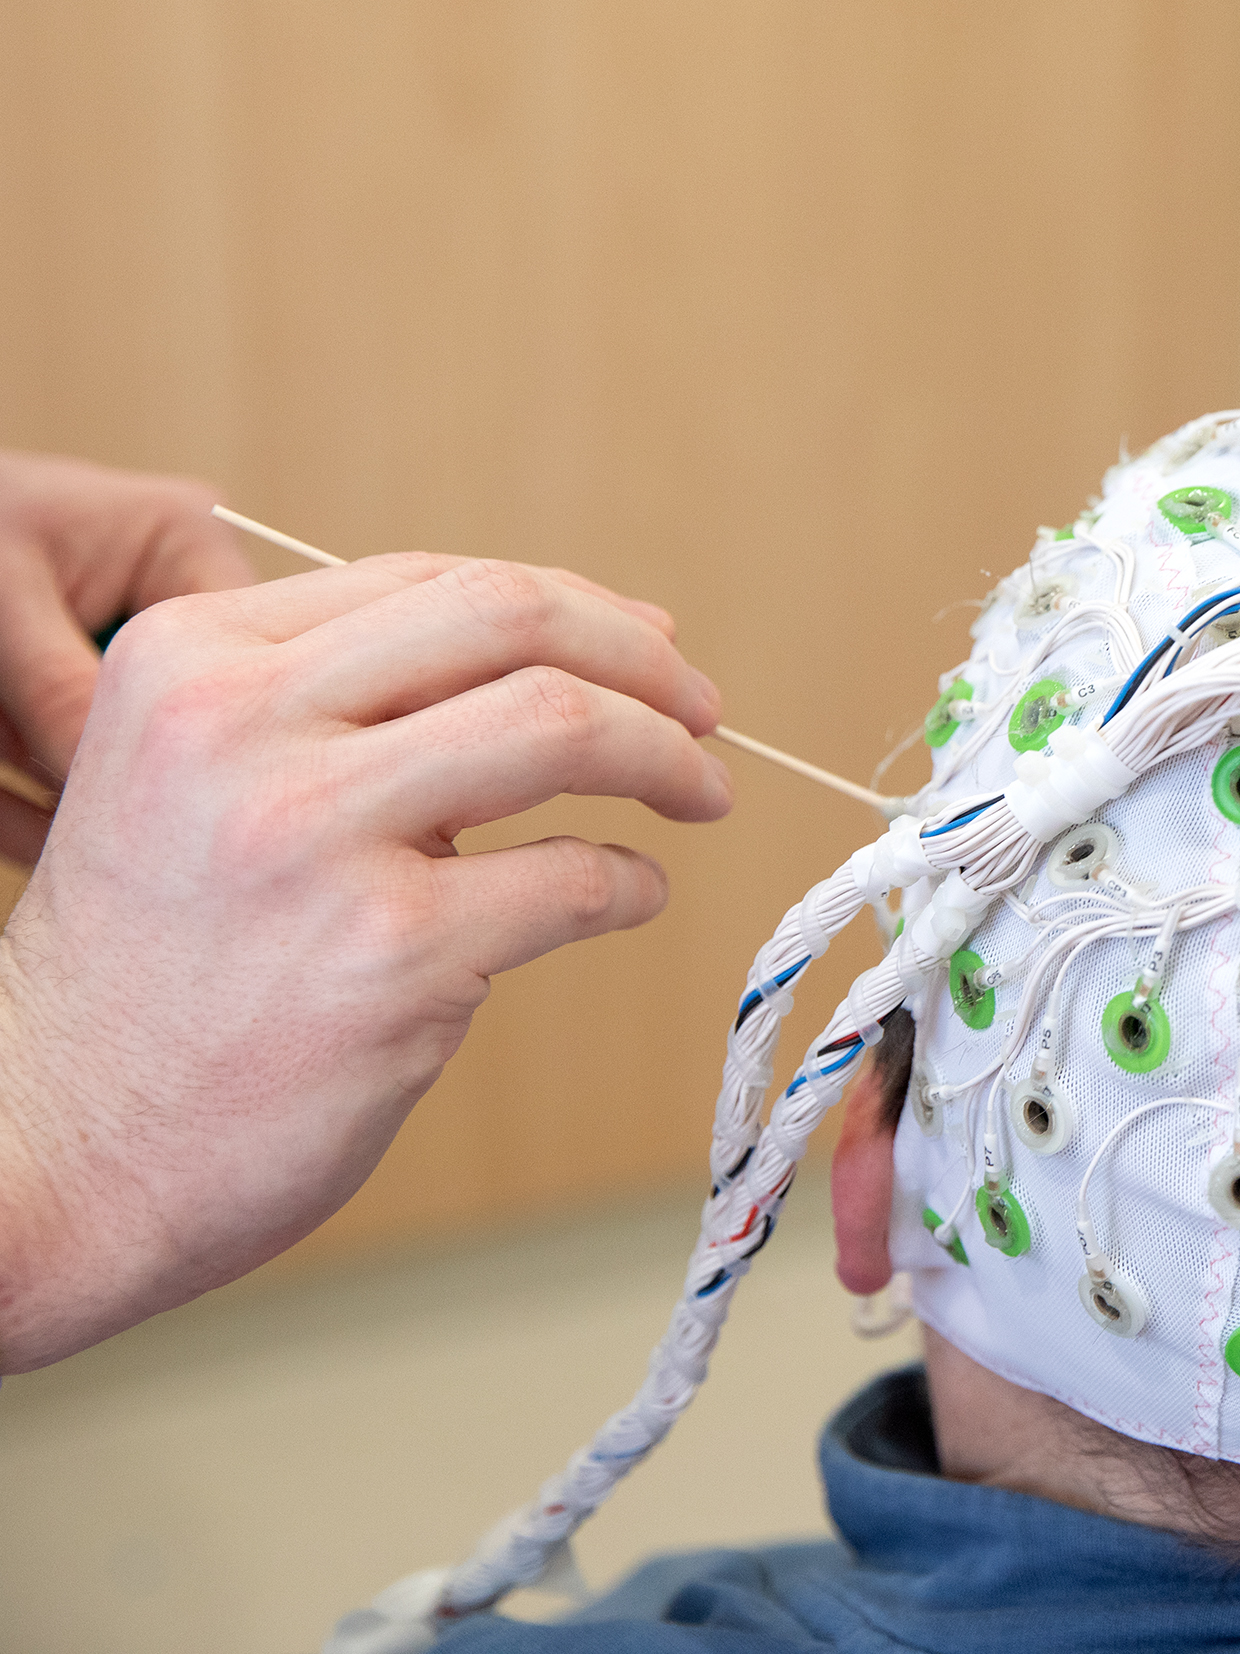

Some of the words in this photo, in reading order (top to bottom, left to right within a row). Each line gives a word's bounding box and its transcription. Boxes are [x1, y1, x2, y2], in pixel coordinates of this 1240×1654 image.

[1078, 684, 1095, 698] C3
[1107, 880, 1127, 898] CP3
[1148, 951, 1163, 972] P3
[1041, 1029, 1051, 1050] P5
[984, 1146, 994, 1167] P7
